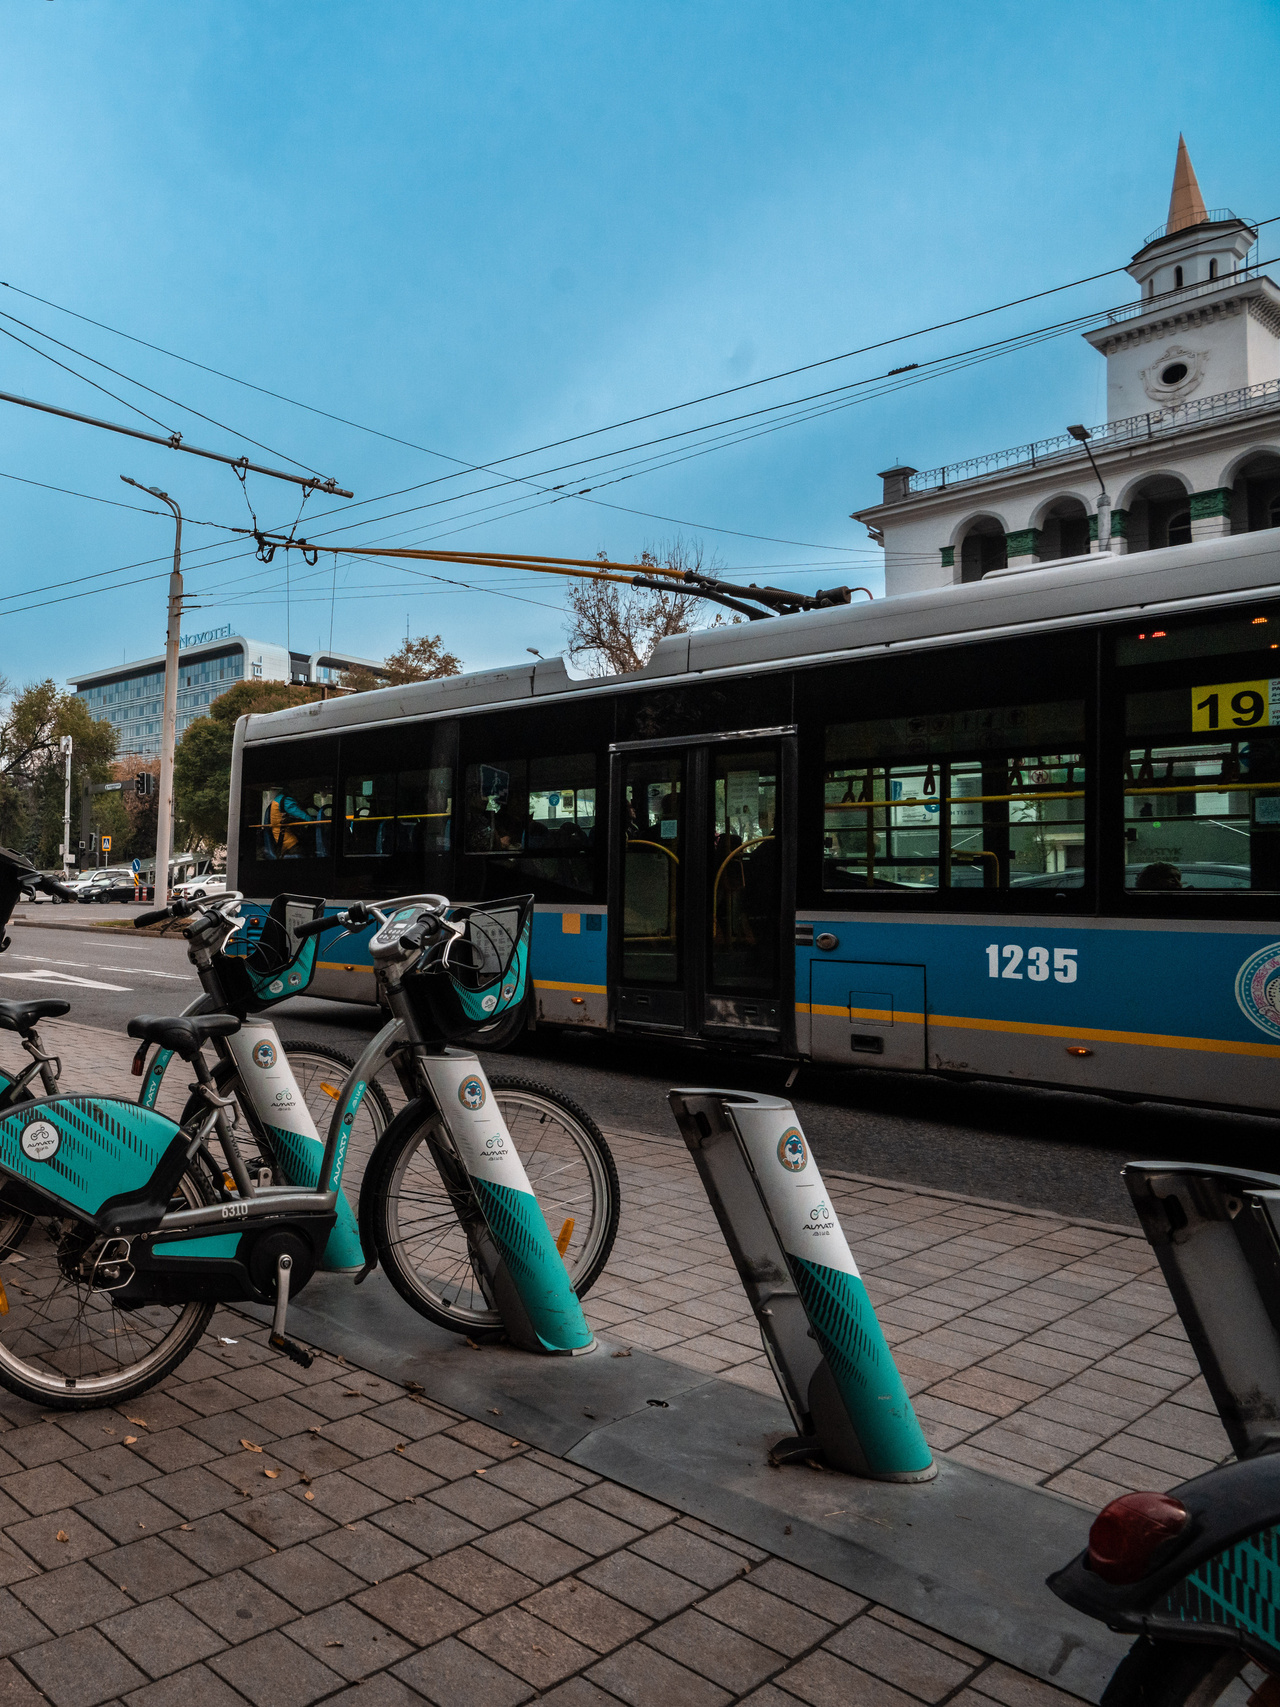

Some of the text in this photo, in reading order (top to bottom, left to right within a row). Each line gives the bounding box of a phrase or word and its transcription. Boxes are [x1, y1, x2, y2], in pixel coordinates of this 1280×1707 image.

[179, 623, 235, 649] NOVOTEL
[1197, 690, 1265, 729] 19
[985, 944, 1078, 984] 1235
[145, 1081, 157, 1108] MATY
[27, 1139, 55, 1149] ALMATY
[333, 1132, 347, 1185] ALMATY
[222, 1203, 248, 1218] 6310
[802, 1222, 835, 1230] ALMATY
